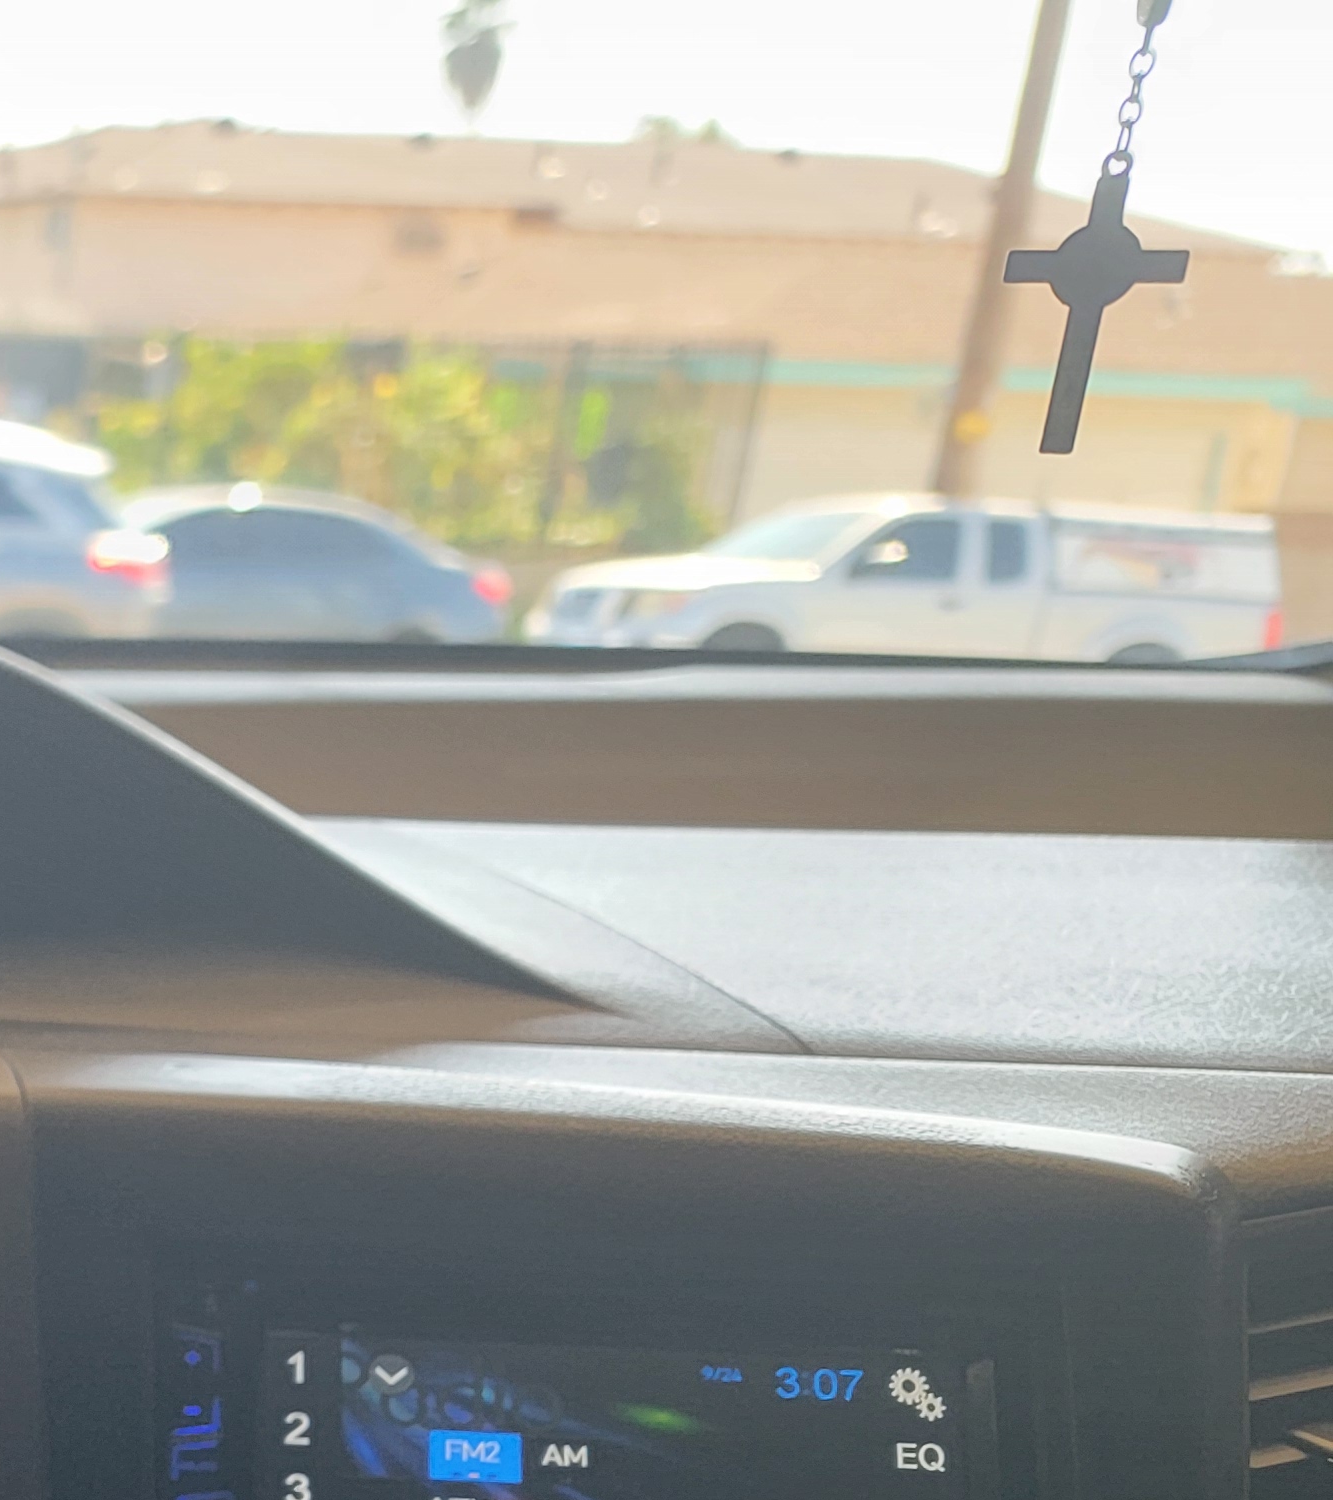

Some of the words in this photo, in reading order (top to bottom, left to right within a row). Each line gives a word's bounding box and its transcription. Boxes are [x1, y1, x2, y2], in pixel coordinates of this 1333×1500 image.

[287, 1350, 306, 1385] 1
[774, 1365, 864, 1401] 3:07
[283, 1411, 311, 1446] 2
[444, 1440, 501, 1464] FM2
[541, 1443, 589, 1468] AM
[895, 1442, 945, 1473] EQ
